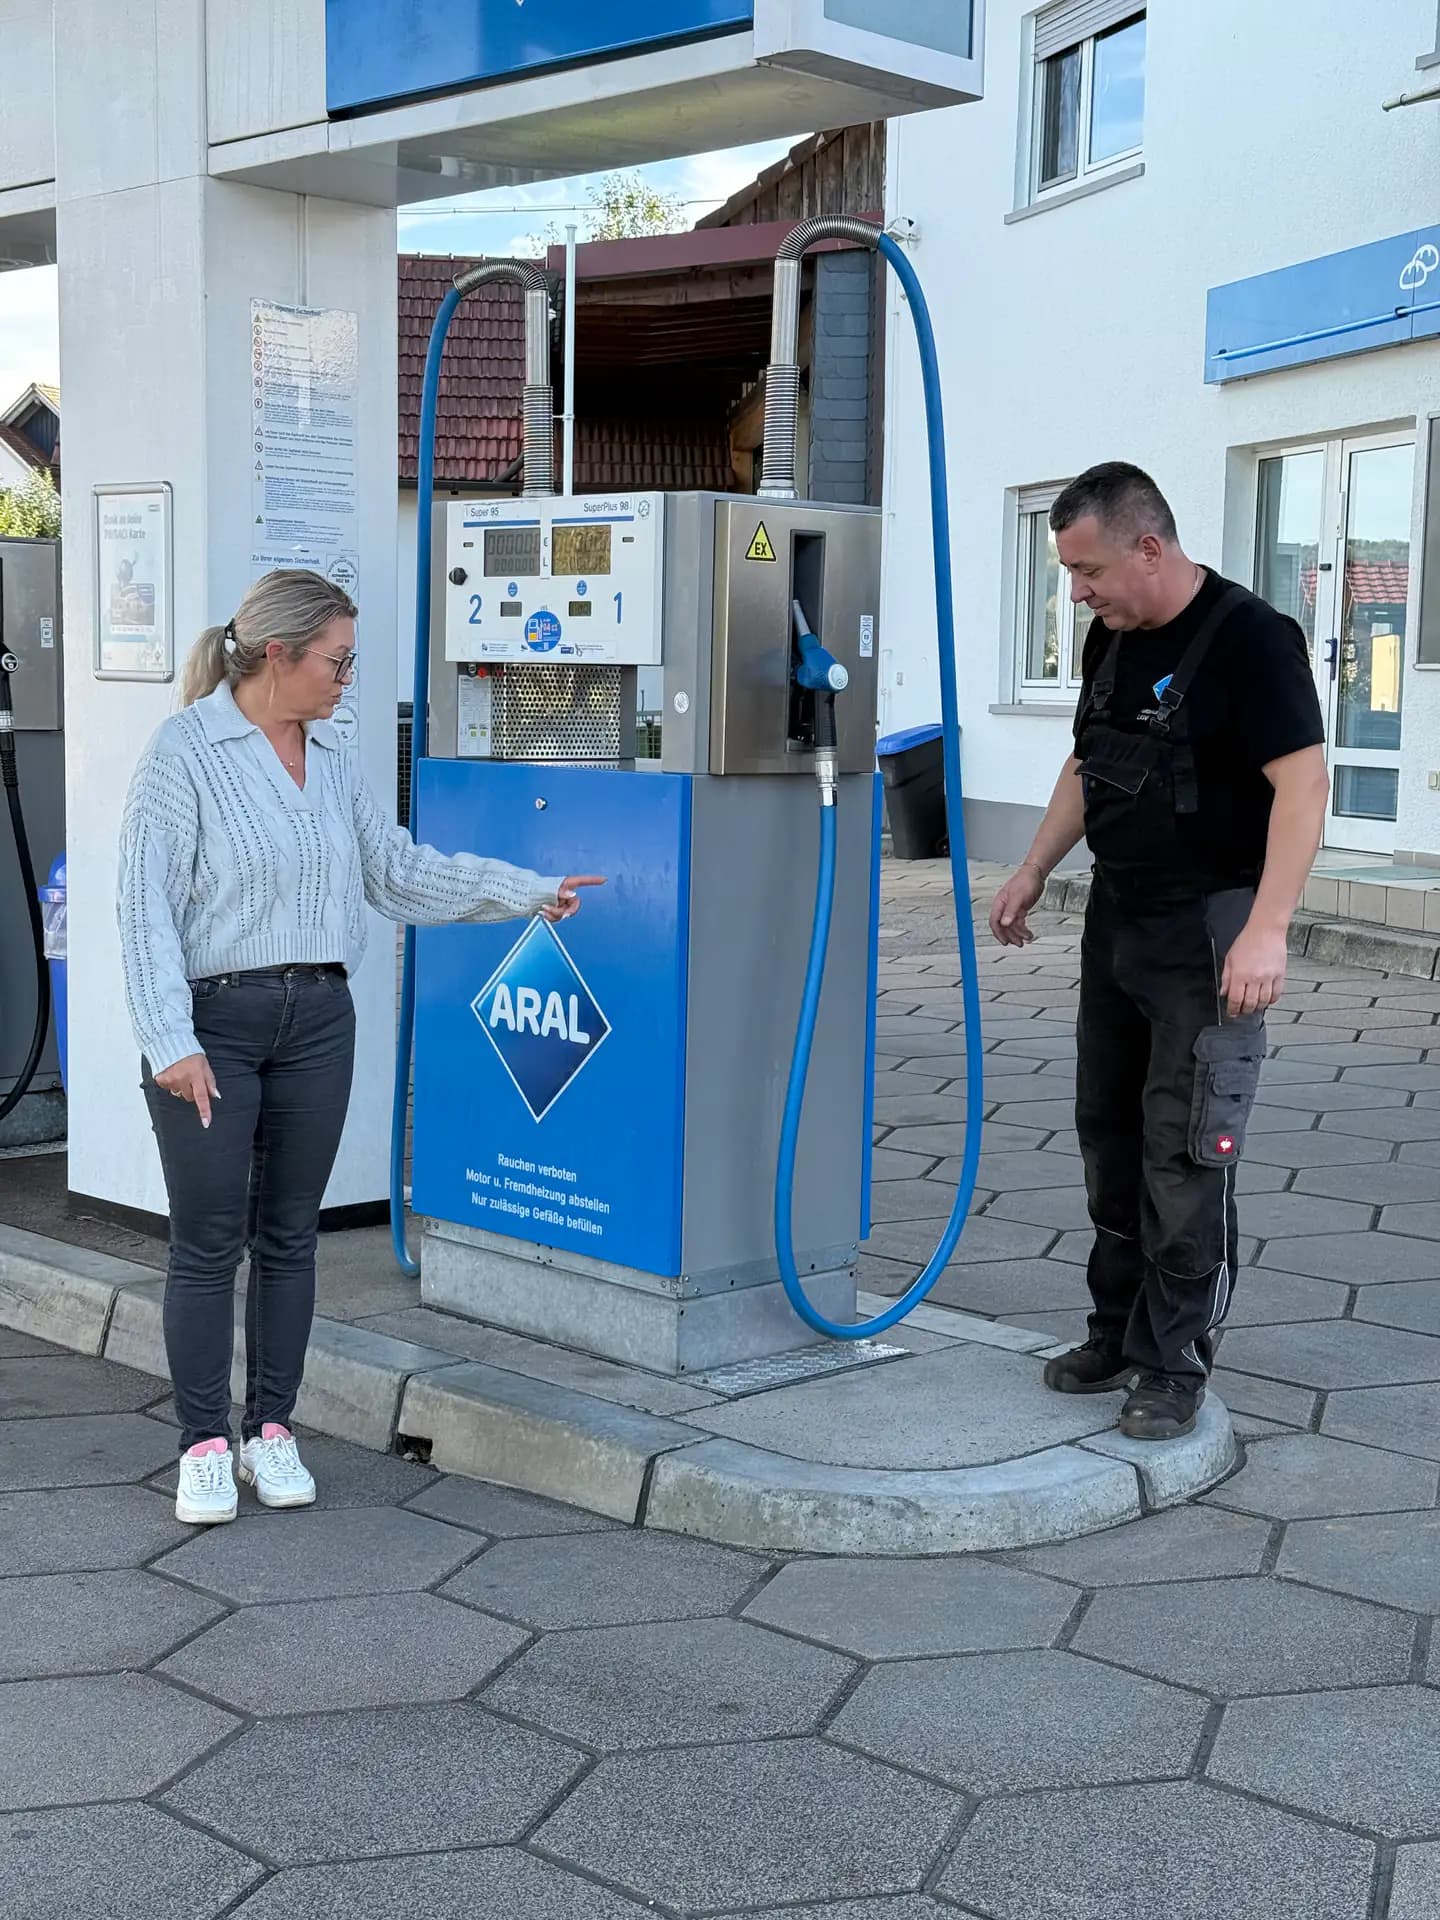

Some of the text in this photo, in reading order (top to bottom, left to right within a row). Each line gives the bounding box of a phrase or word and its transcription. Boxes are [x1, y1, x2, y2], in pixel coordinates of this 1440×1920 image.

[470, 507, 499, 518] Super 95
[583, 501, 629, 513] SuperPlus 98
[754, 542, 767, 556] EX
[468, 594, 483, 625] 2
[613, 591, 623, 625] 1
[489, 983, 590, 1045] ARAL
[497, 1153, 577, 1183] Rauchen verboten
[465, 1168, 610, 1215] Motor u. Fremdheizung abstellen
[471, 1191, 603, 1236] Nur zulässige Gefäße befüllen
